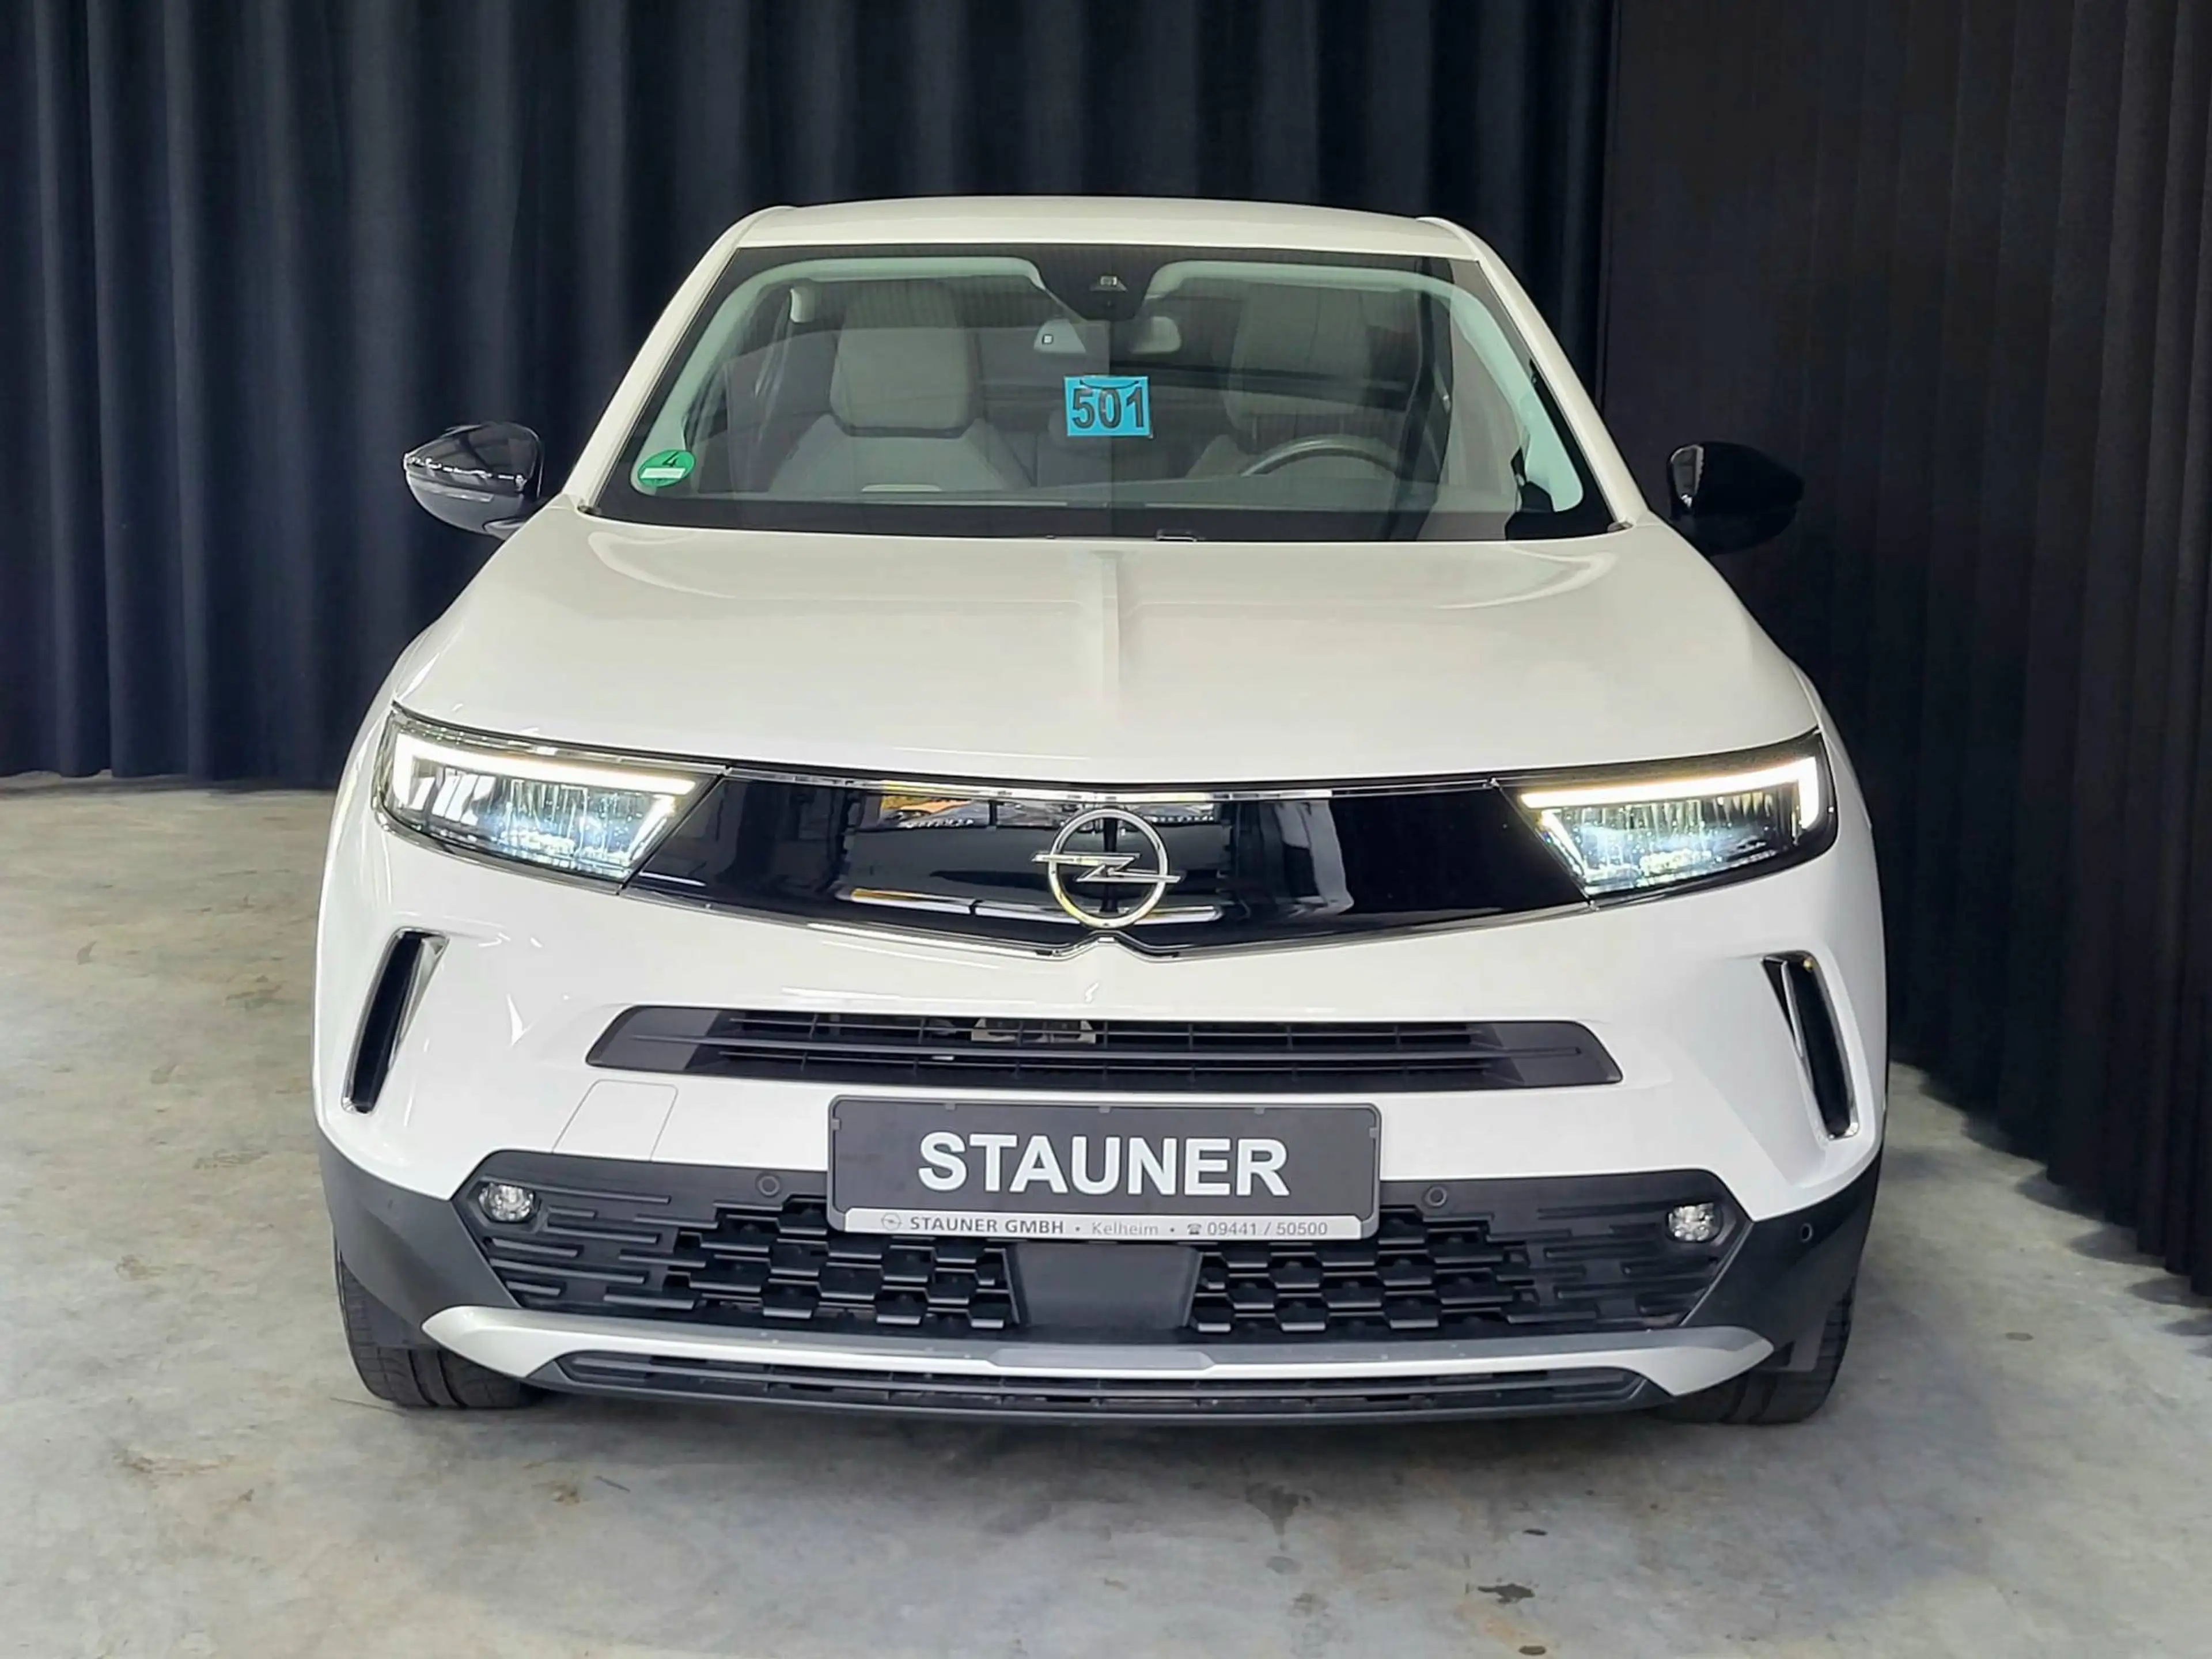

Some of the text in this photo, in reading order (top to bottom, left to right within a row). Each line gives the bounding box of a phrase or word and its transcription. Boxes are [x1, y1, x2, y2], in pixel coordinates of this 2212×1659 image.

[1071, 387, 1144, 429] 501
[662, 451, 680, 467] 4
[918, 1131, 1290, 1197] STAUNER
[910, 1215, 998, 1233] STAUNER
[1005, 1219, 1065, 1234] GMBH
[1092, 1221, 1158, 1236] Kelheim
[1207, 1222, 1256, 1236] 09441
[1275, 1222, 1328, 1237] 50500
